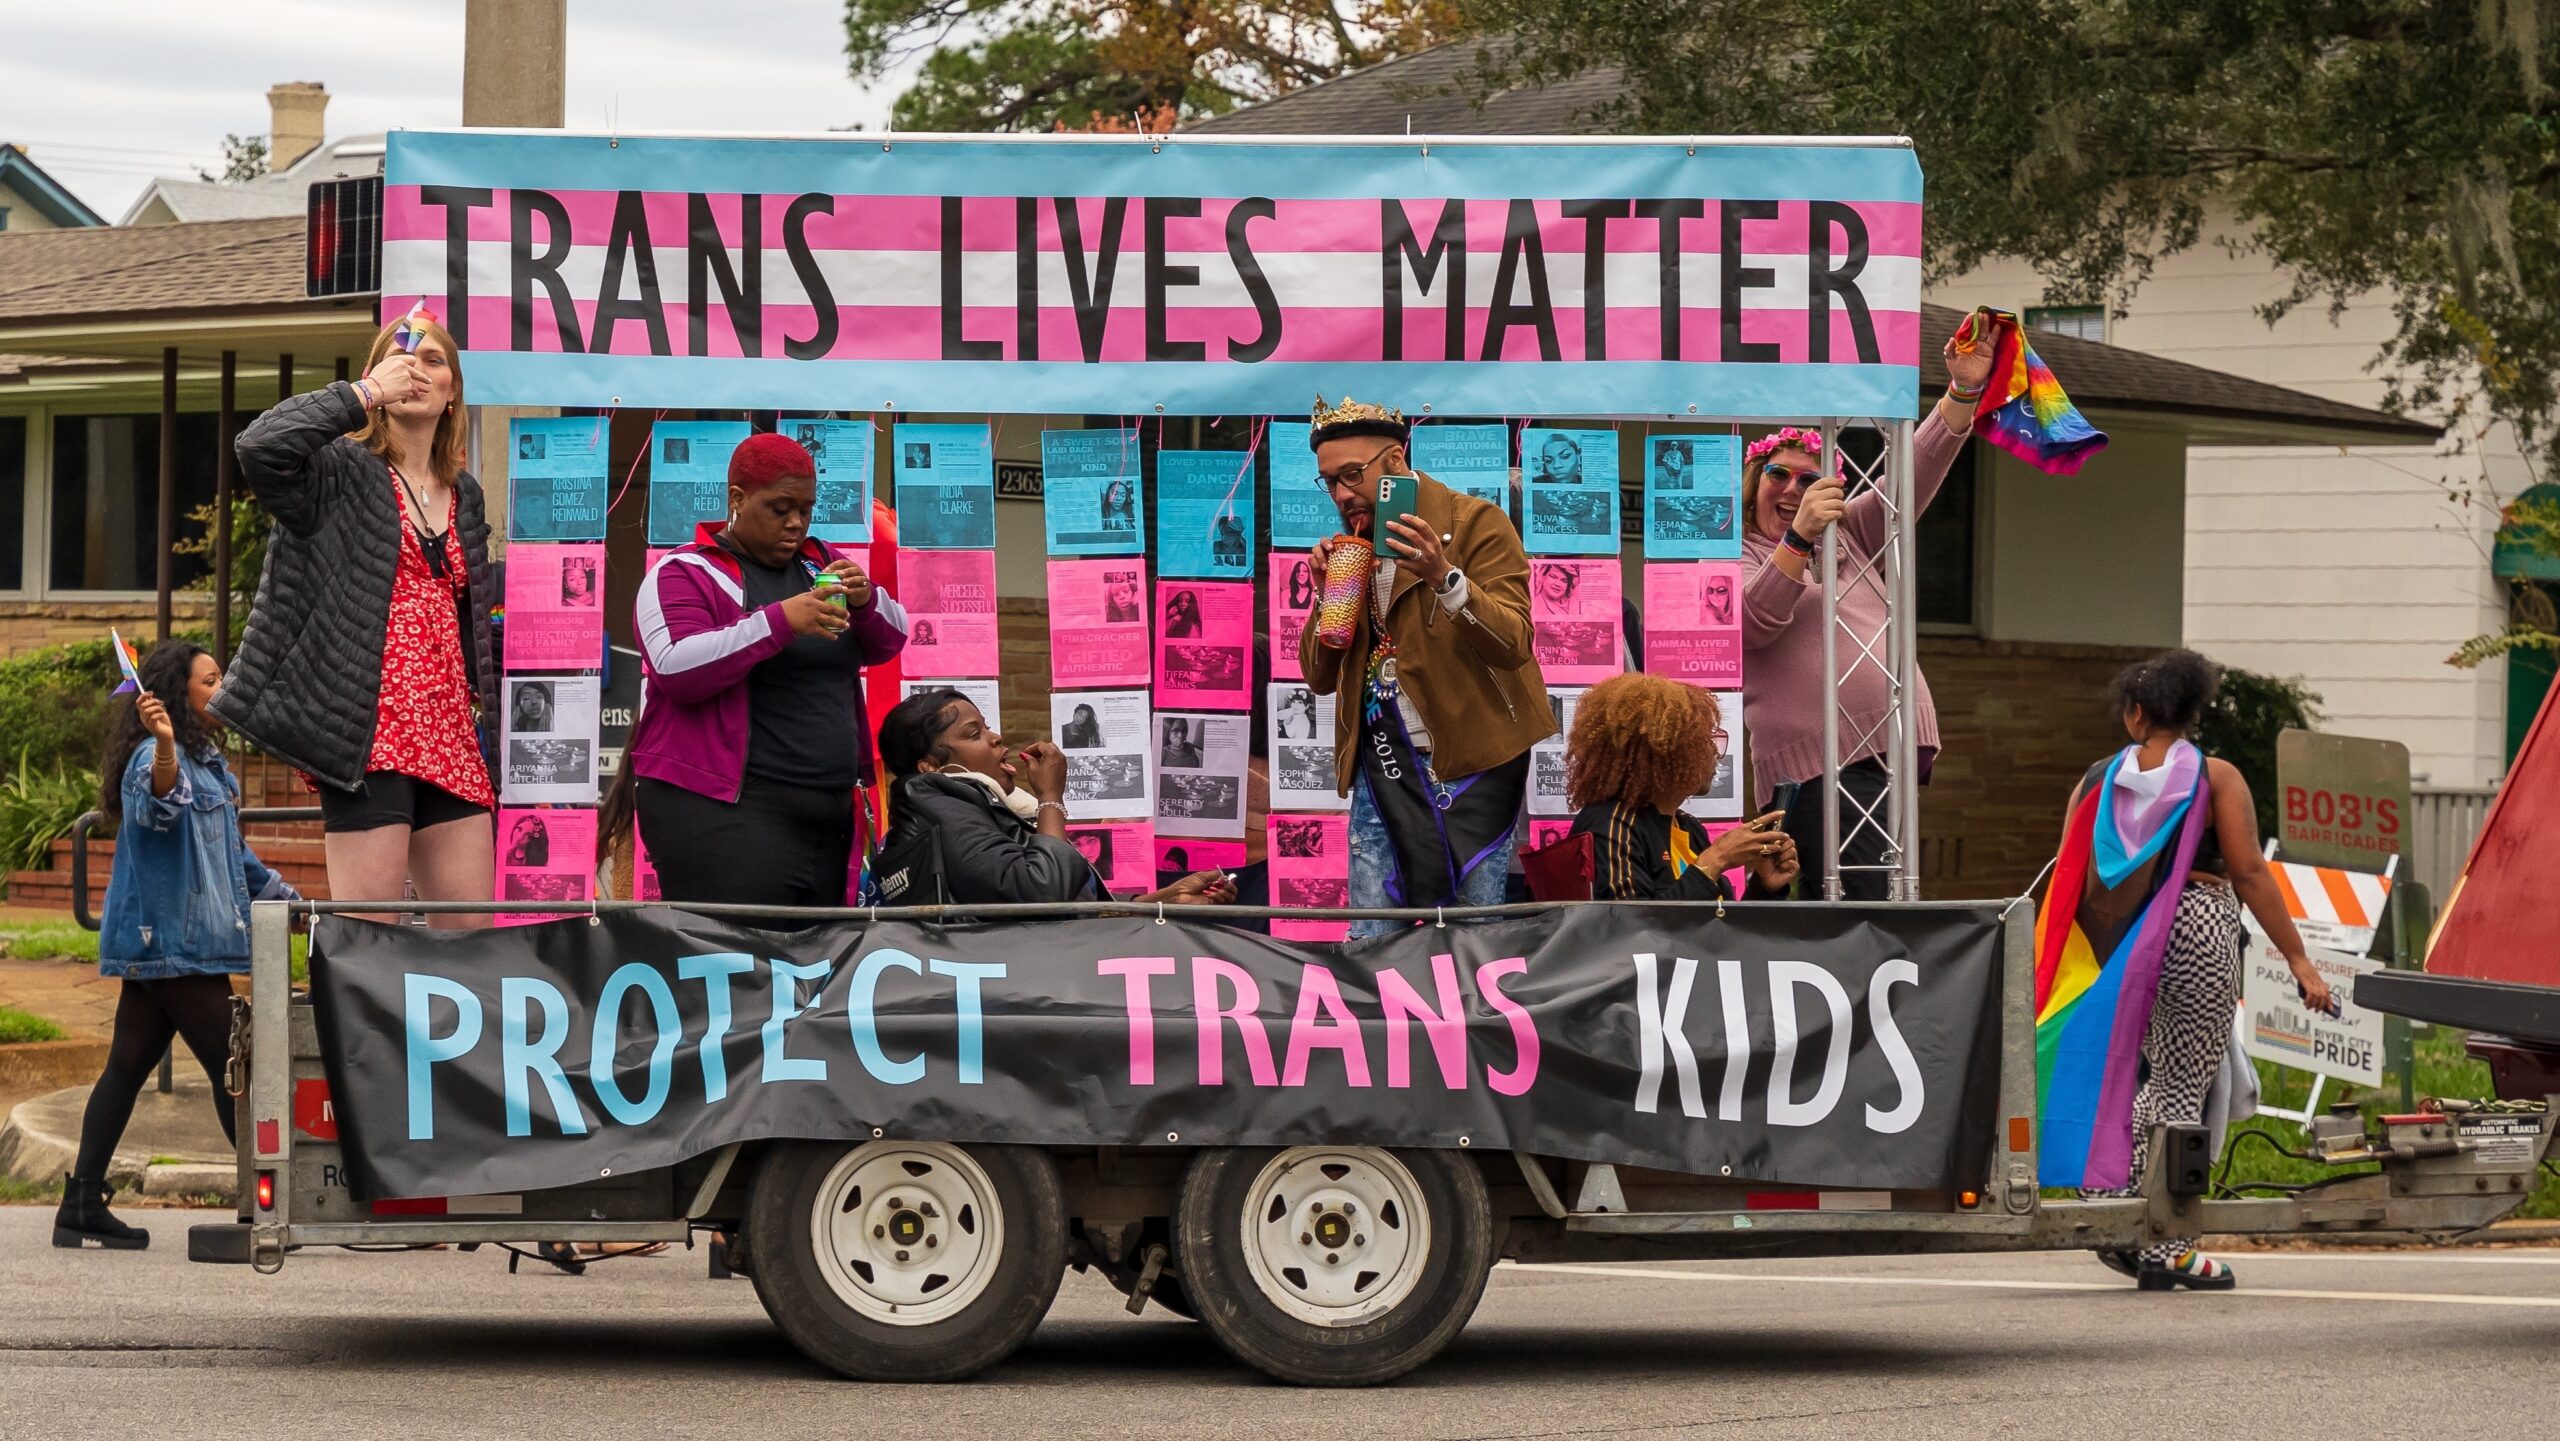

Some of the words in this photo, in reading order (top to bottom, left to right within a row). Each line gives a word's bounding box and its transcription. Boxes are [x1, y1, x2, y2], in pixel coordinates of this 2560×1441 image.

[421, 184, 838, 360] TRANS
[940, 196, 1282, 363] LIVES
[1381, 198, 1881, 363] MATTER
[1052, 438, 1060, 447] A
[1063, 437, 1100, 447] SWEET
[1445, 431, 1496, 441] BRAVE
[1047, 446, 1067, 454] LAID
[1418, 441, 1504, 450] INSPIRATIONAL
[1048, 452, 1137, 464] THOUGHTFUL
[1163, 458, 1196, 467] LOVED
[1200, 458, 1213, 467] TO
[1430, 456, 1502, 468] TALENTED
[1081, 463, 1107, 472] KIND
[553, 477, 592, 490] KRISTINA
[1187, 473, 1247, 485] DANCER
[694, 482, 720, 495] CHAY
[940, 485, 963, 498] INDIA
[552, 491, 585, 506] GOMEZ
[693, 497, 720, 510] REED
[940, 501, 975, 514] CLARKE
[1281, 503, 1319, 514] BOLD
[552, 507, 599, 522] REINWALD
[1275, 514, 1324, 523] PAGEANT
[1533, 525, 1579, 534] PRINCESS
[509, 630, 579, 639] PROTECTIVE
[582, 630, 599, 640] OF
[1062, 632, 1140, 644] FIRECRACKER
[509, 639, 533, 648] HER
[536, 639, 577, 648] FAMILY
[1649, 639, 1693, 648] ANIMAL
[1695, 639, 1730, 648] LOVER
[1066, 647, 1133, 663] GIFTED
[1061, 663, 1124, 673] AUTHENTIC
[1681, 660, 1737, 671] LOVING
[1371, 731, 1402, 780] 2019
[509, 775, 556, 784] MITCHELL
[1279, 780, 1324, 789] VASQUEZ
[1159, 798, 1204, 808] SERENITY
[1159, 809, 1192, 818] HOLLIS
[2286, 785, 2400, 836] BOB'S
[2287, 825, 2400, 853] BARRICADES
[404, 948, 1006, 1141] PROTECT
[1097, 953, 1541, 1096] TRANS
[1631, 953, 1925, 1134] KIDS
[2314, 1028, 2345, 1044] RIVER
[2348, 1036, 2373, 1052] CITY
[2314, 1040, 2373, 1071] PRIDE
[2460, 1125, 2505, 1136] HYDRAULIC
[2508, 1124, 2540, 1134] BRAKES
